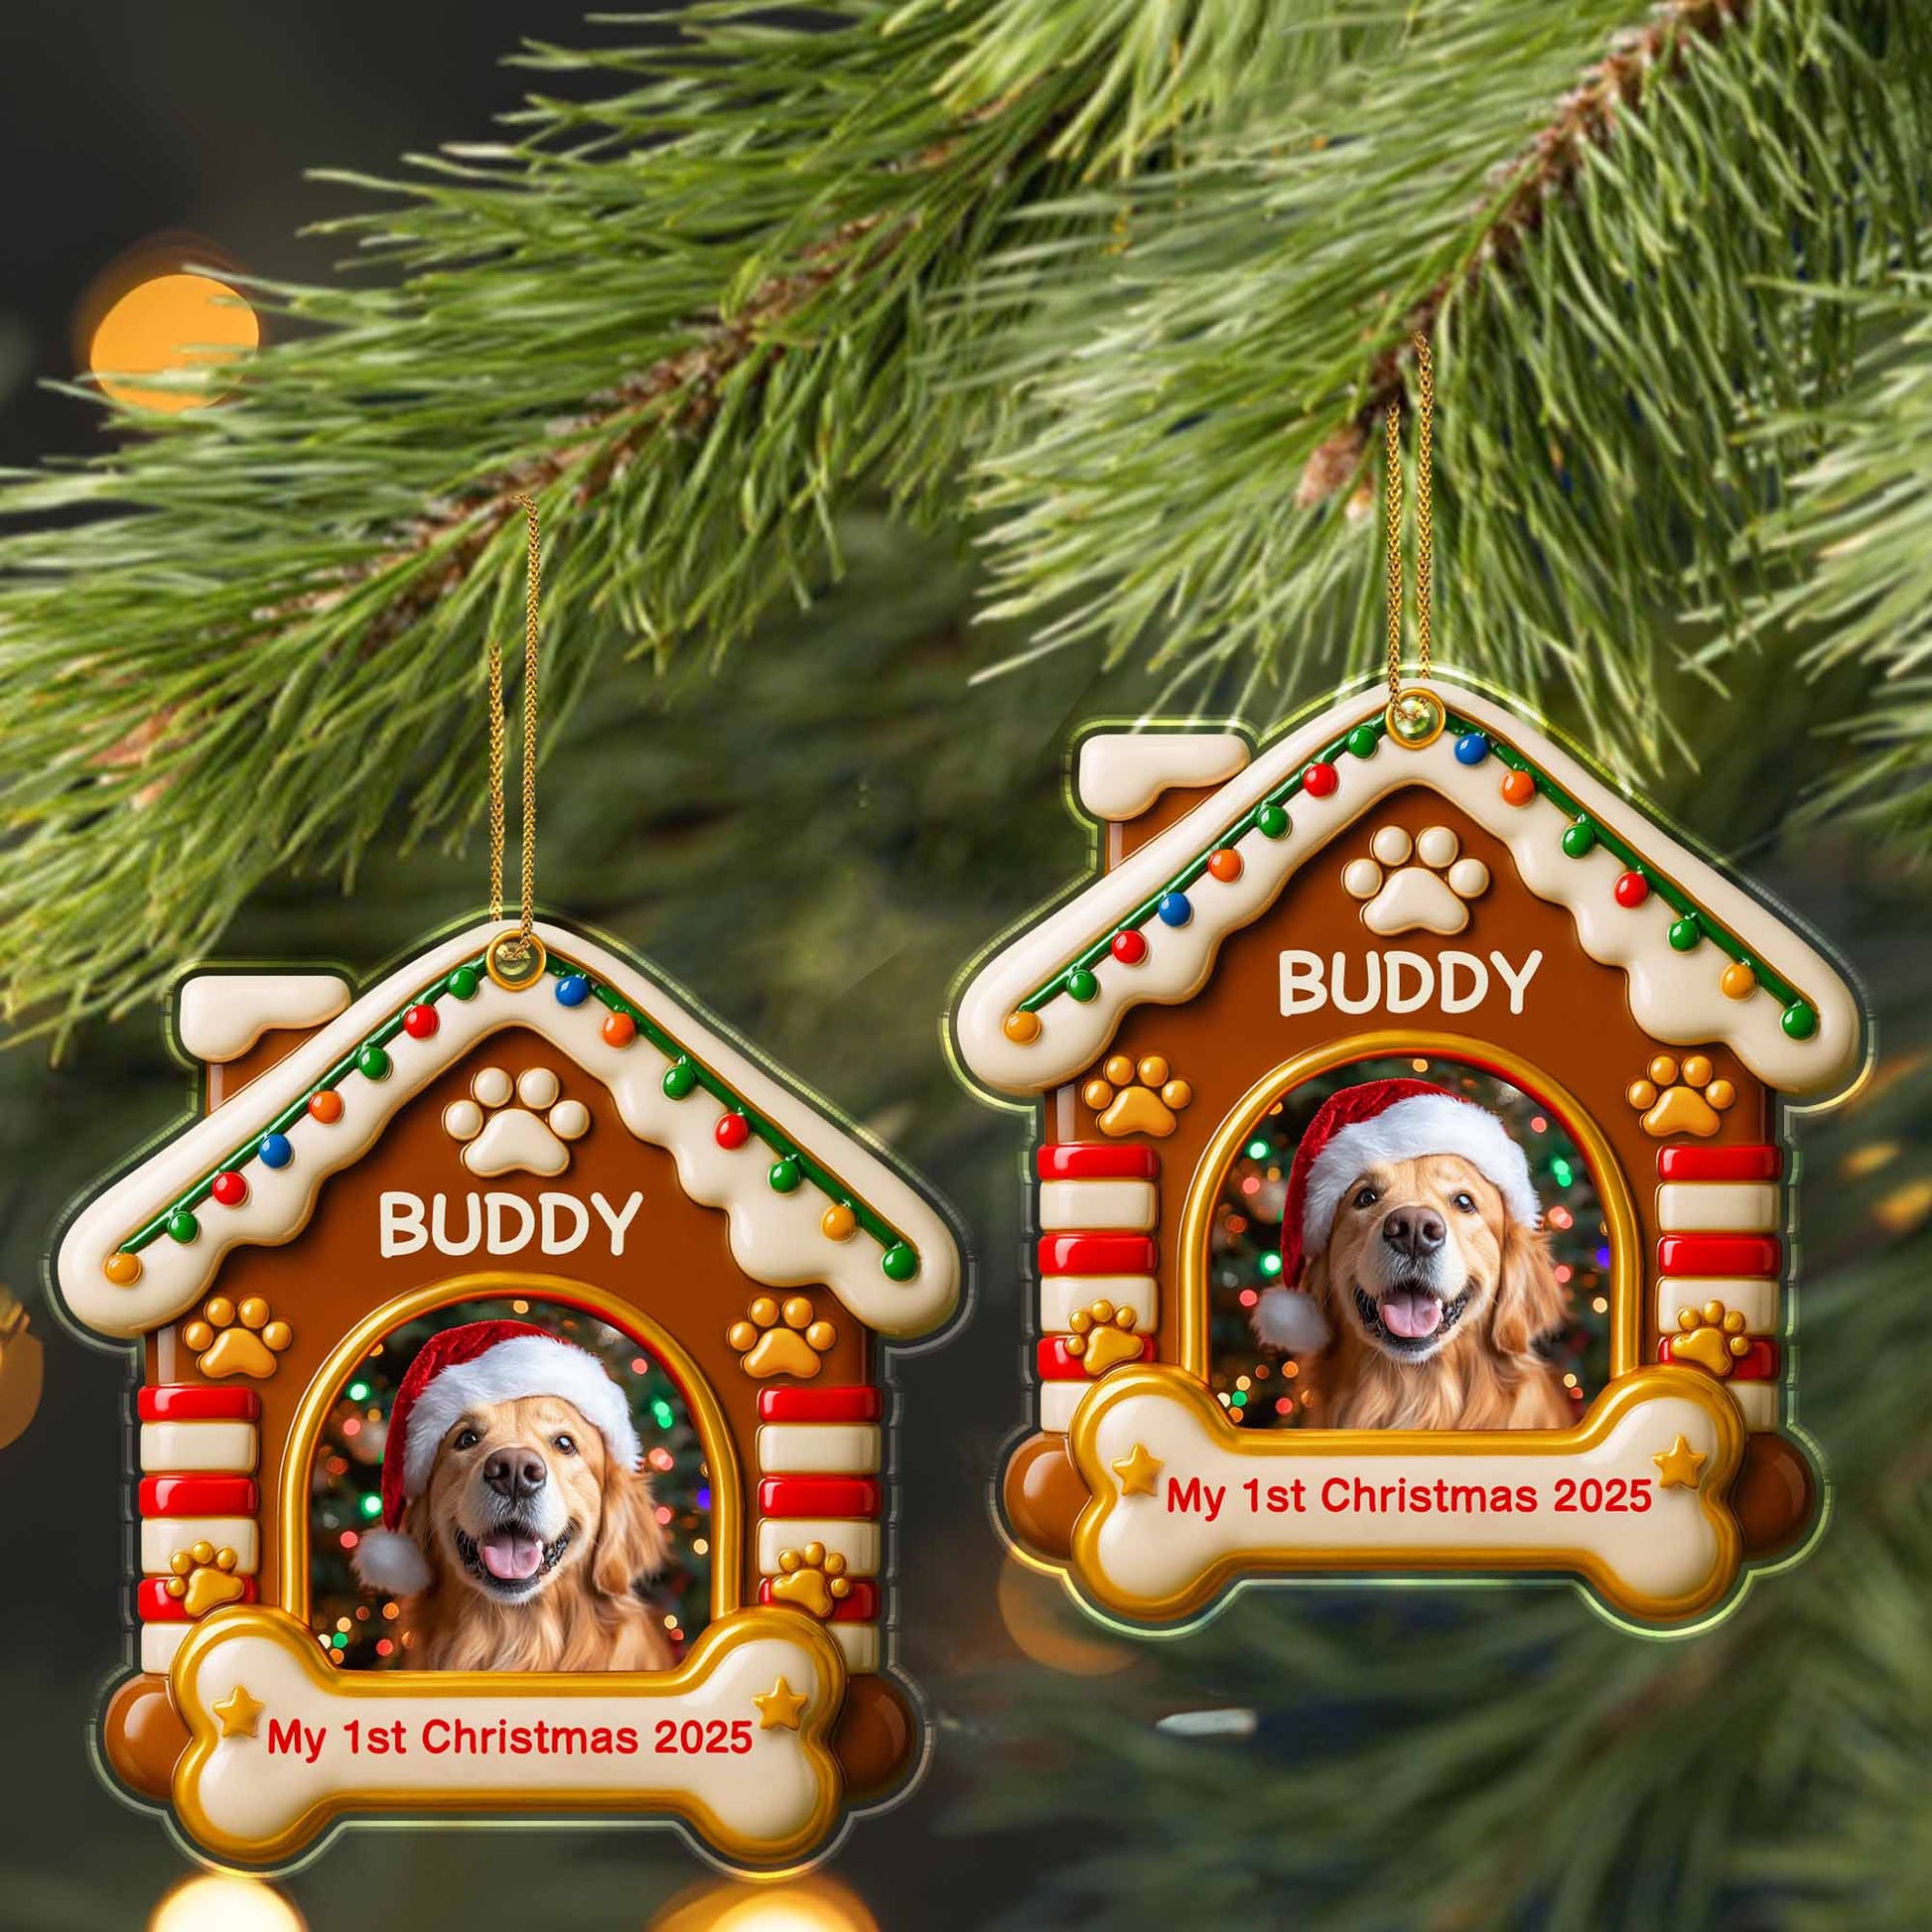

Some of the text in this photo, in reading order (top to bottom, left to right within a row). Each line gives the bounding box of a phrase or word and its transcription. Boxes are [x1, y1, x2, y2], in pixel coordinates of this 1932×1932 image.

[1279, 949, 1543, 1017] BUDDY
[379, 1191, 643, 1258] BUDDY
[1167, 1476, 1652, 1523] My 1st Christmas 2025
[268, 1718, 753, 1764] My 1st Christmas 2025
